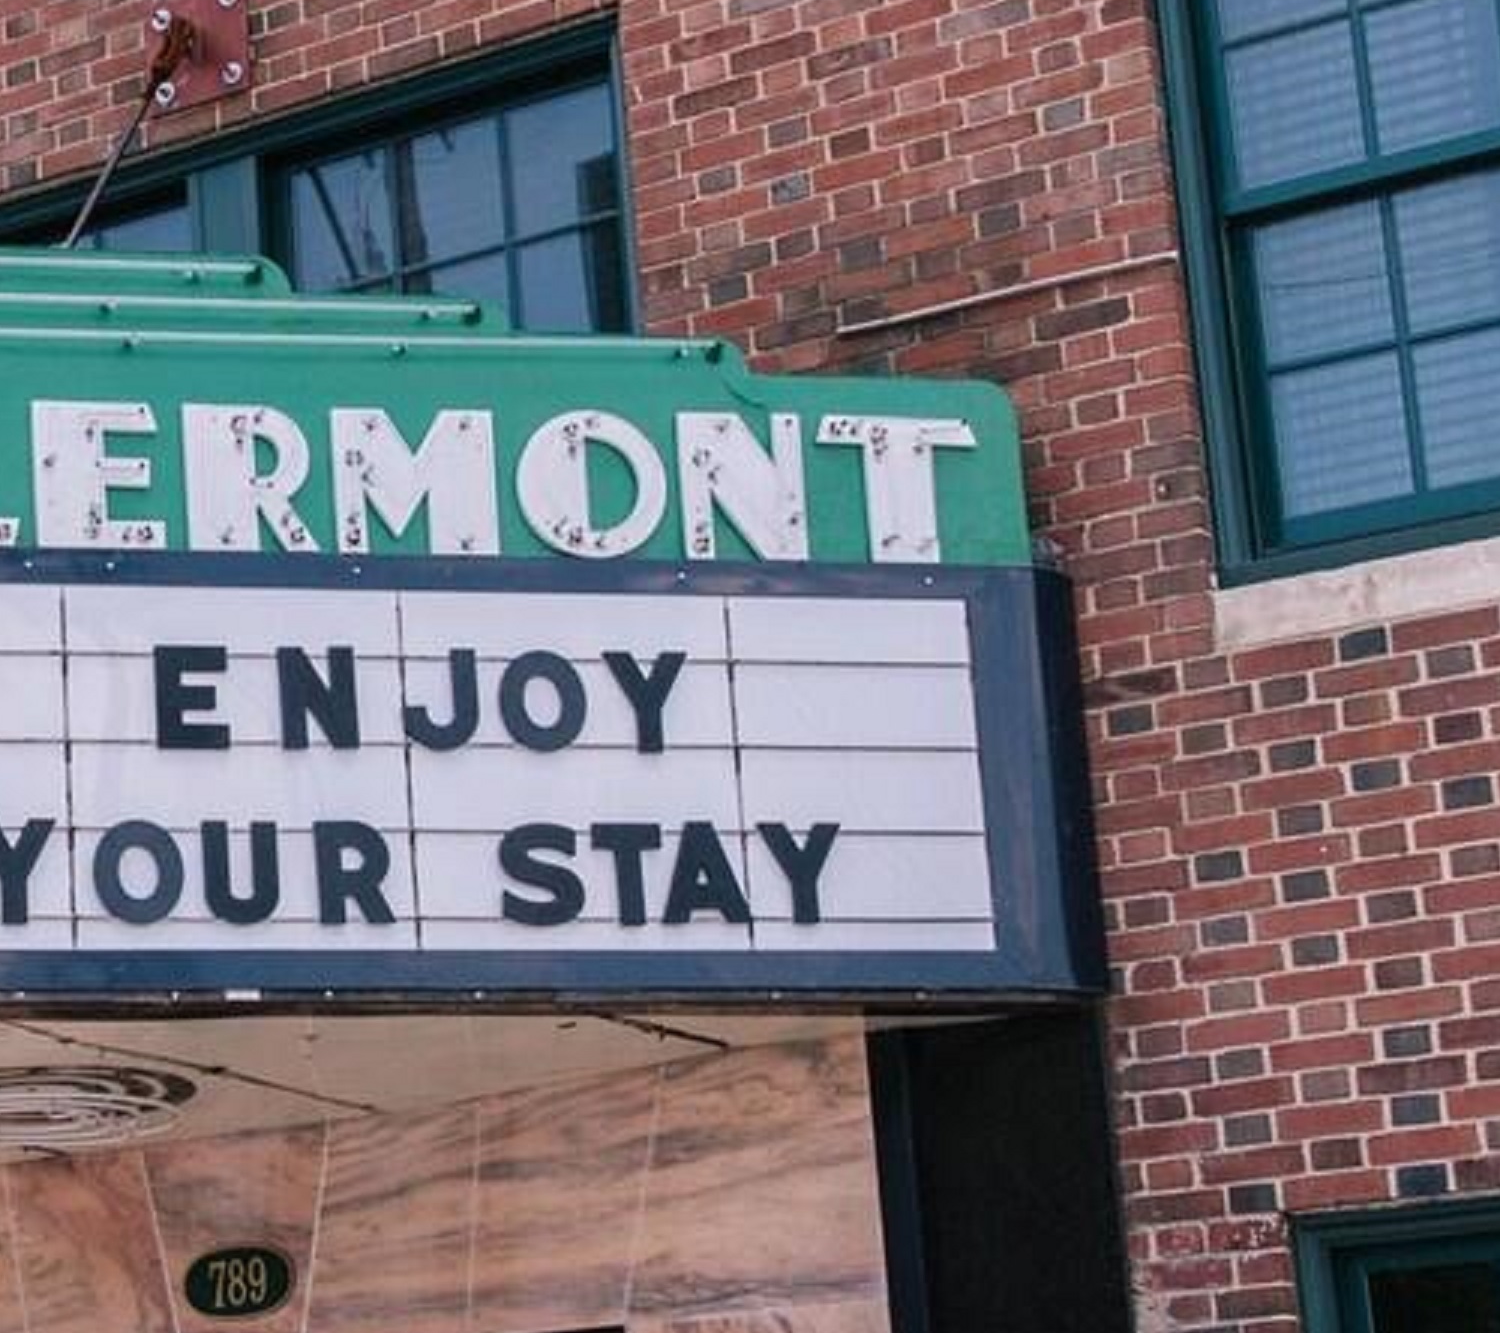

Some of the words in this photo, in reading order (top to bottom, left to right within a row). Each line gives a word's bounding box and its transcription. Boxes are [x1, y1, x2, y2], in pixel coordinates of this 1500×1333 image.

[152, 644, 687, 754] ENJOY
[500, 821, 841, 928] STAY
[208, 1256, 268, 1308] 789
